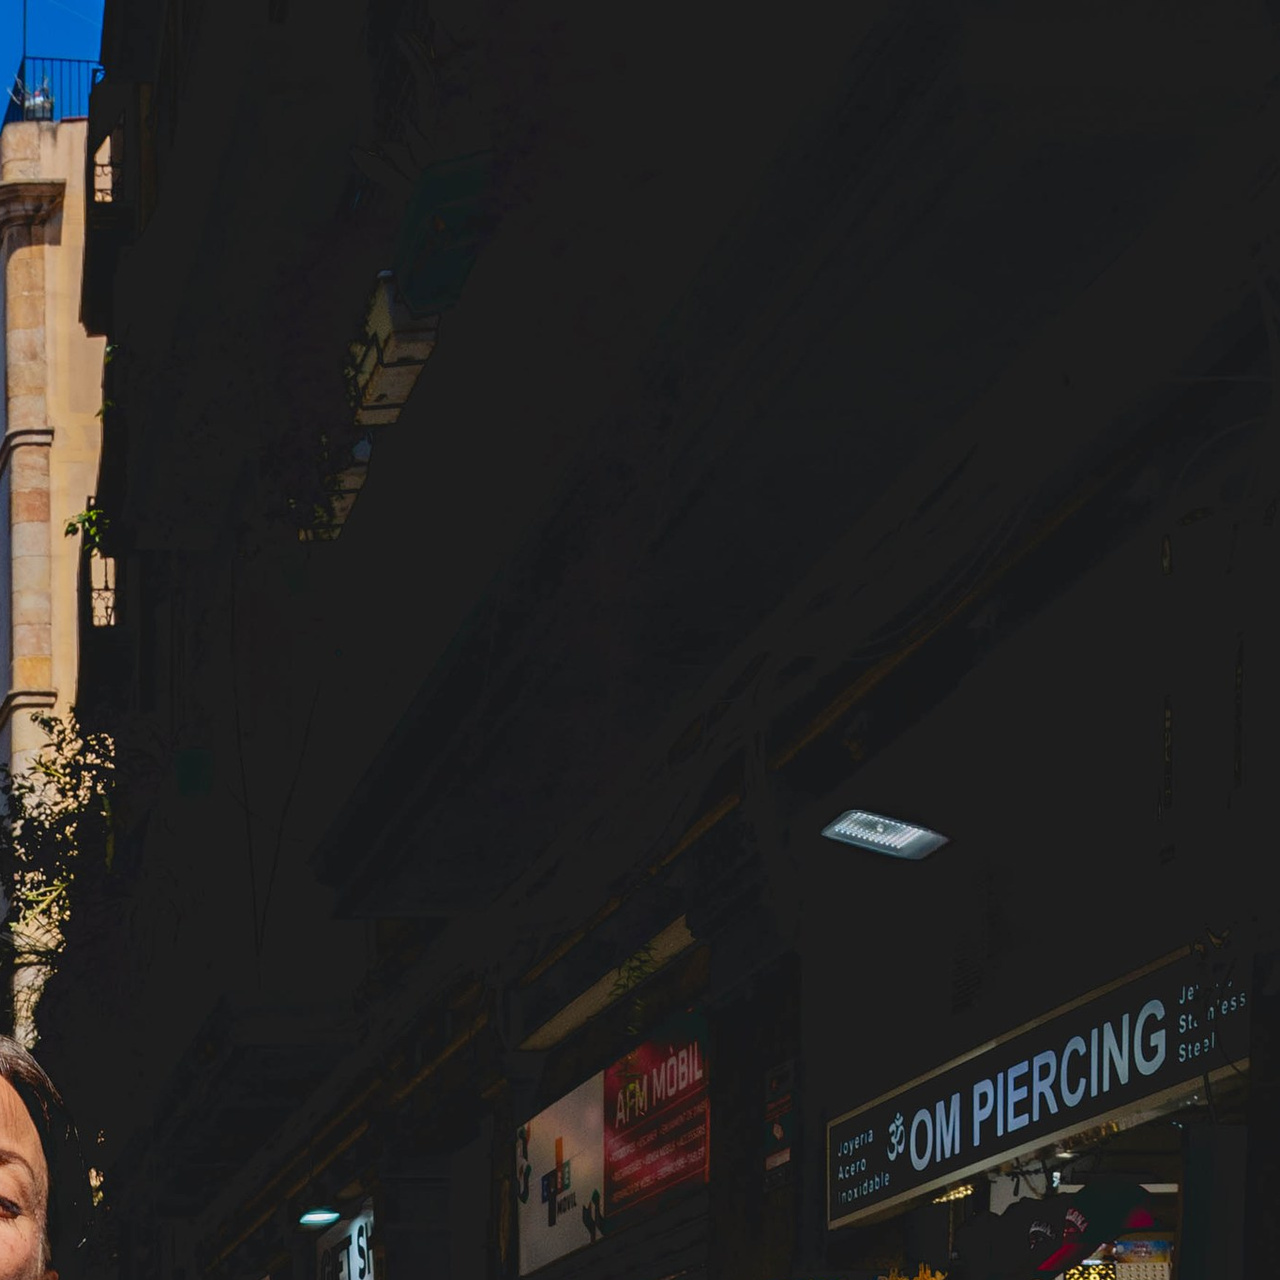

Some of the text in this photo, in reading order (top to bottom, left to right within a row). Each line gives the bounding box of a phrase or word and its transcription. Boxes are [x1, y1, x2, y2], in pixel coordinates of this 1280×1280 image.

[1178, 992, 1246, 1033] Stness
[1178, 1031, 1215, 1062] Steel
[909, 999, 1167, 1172] OM PIERCING
[838, 1158, 867, 1180] Acero
